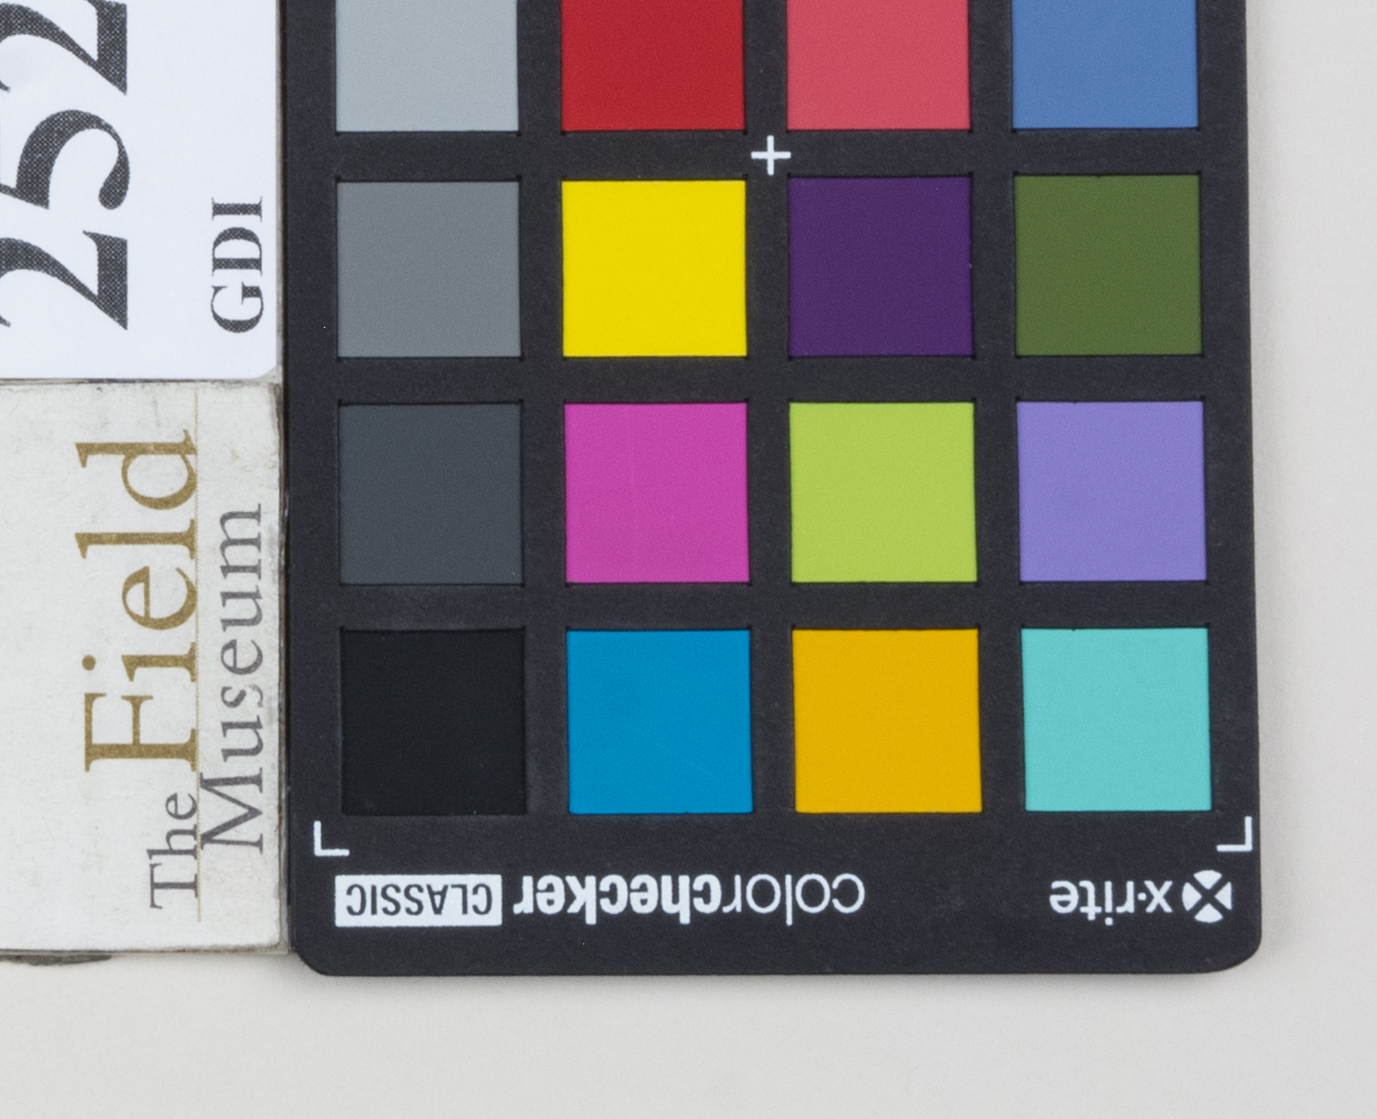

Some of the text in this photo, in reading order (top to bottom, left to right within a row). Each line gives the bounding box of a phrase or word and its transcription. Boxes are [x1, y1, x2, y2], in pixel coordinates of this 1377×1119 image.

[209, 195, 264, 334] GDI
[73, 428, 199, 910] The Field
[198, 502, 264, 854] Museum
[345, 882, 493, 918] CLASSIC
[513, 874, 866, 927] colorchecker
